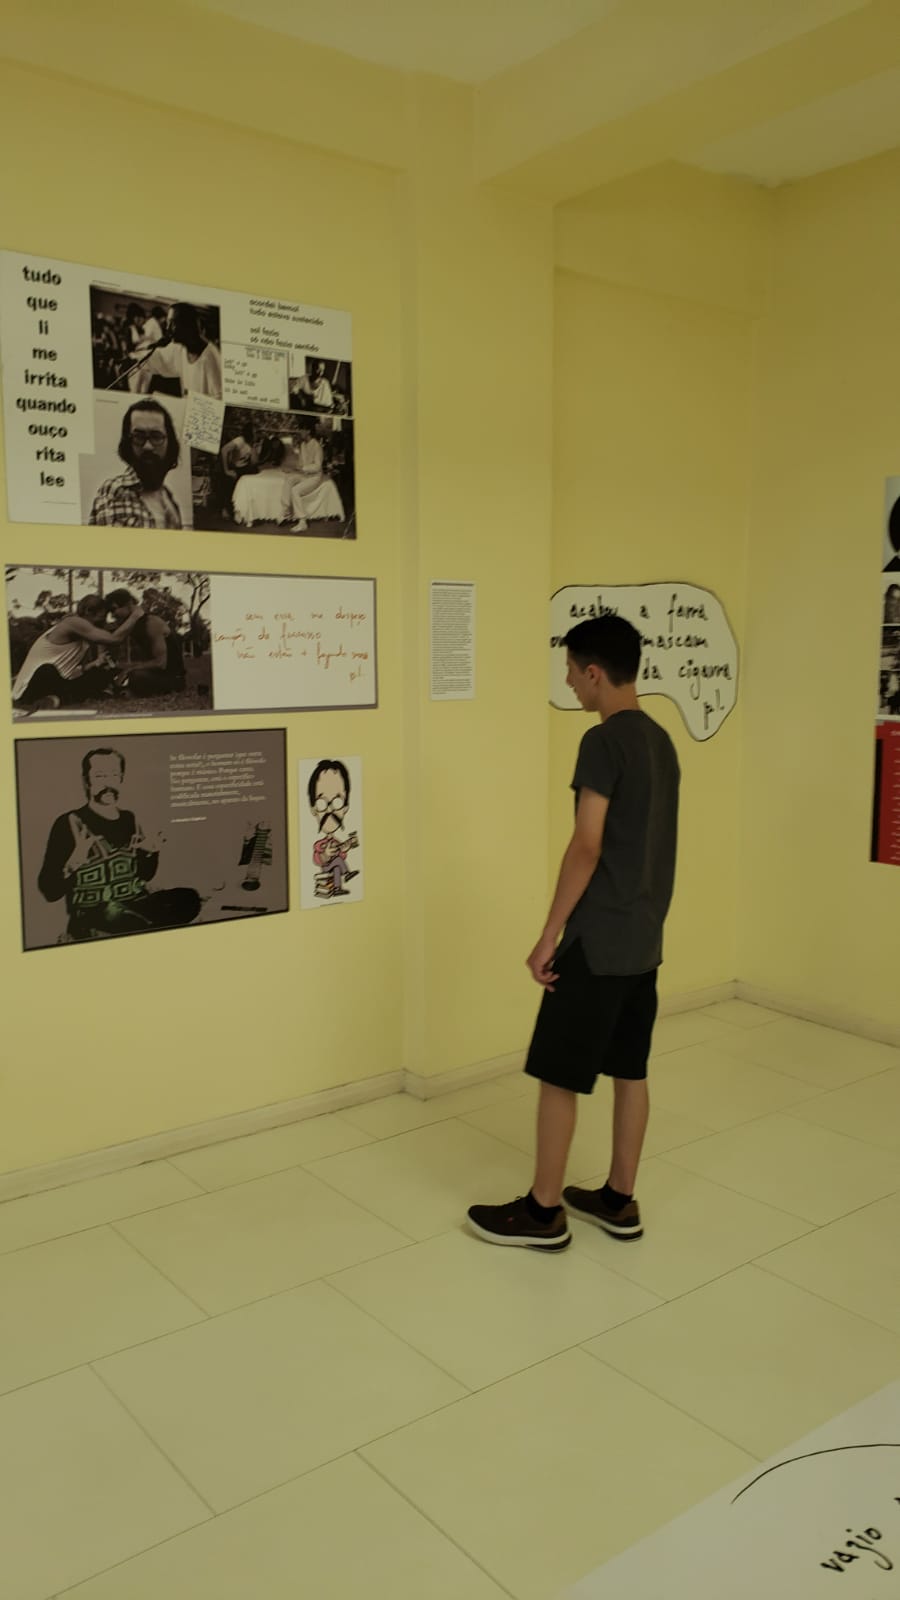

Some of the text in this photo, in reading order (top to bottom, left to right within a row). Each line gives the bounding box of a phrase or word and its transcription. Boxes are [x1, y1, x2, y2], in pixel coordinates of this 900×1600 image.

[22, 265, 62, 286] tudo
[26, 296, 58, 311] que
[38, 320, 49, 335] li
[32, 347, 58, 361] me
[24, 368, 68, 389] irrita
[16, 396, 77, 414] quando
[28, 423, 68, 438] ouço
[36, 446, 66, 463] rita
[40, 471, 65, 487] lee
[570, 595, 618, 616] acabou
[640, 605, 650, 619] a
[640, 635, 708, 650] mascam
[642, 657, 732, 700] da cigarra
